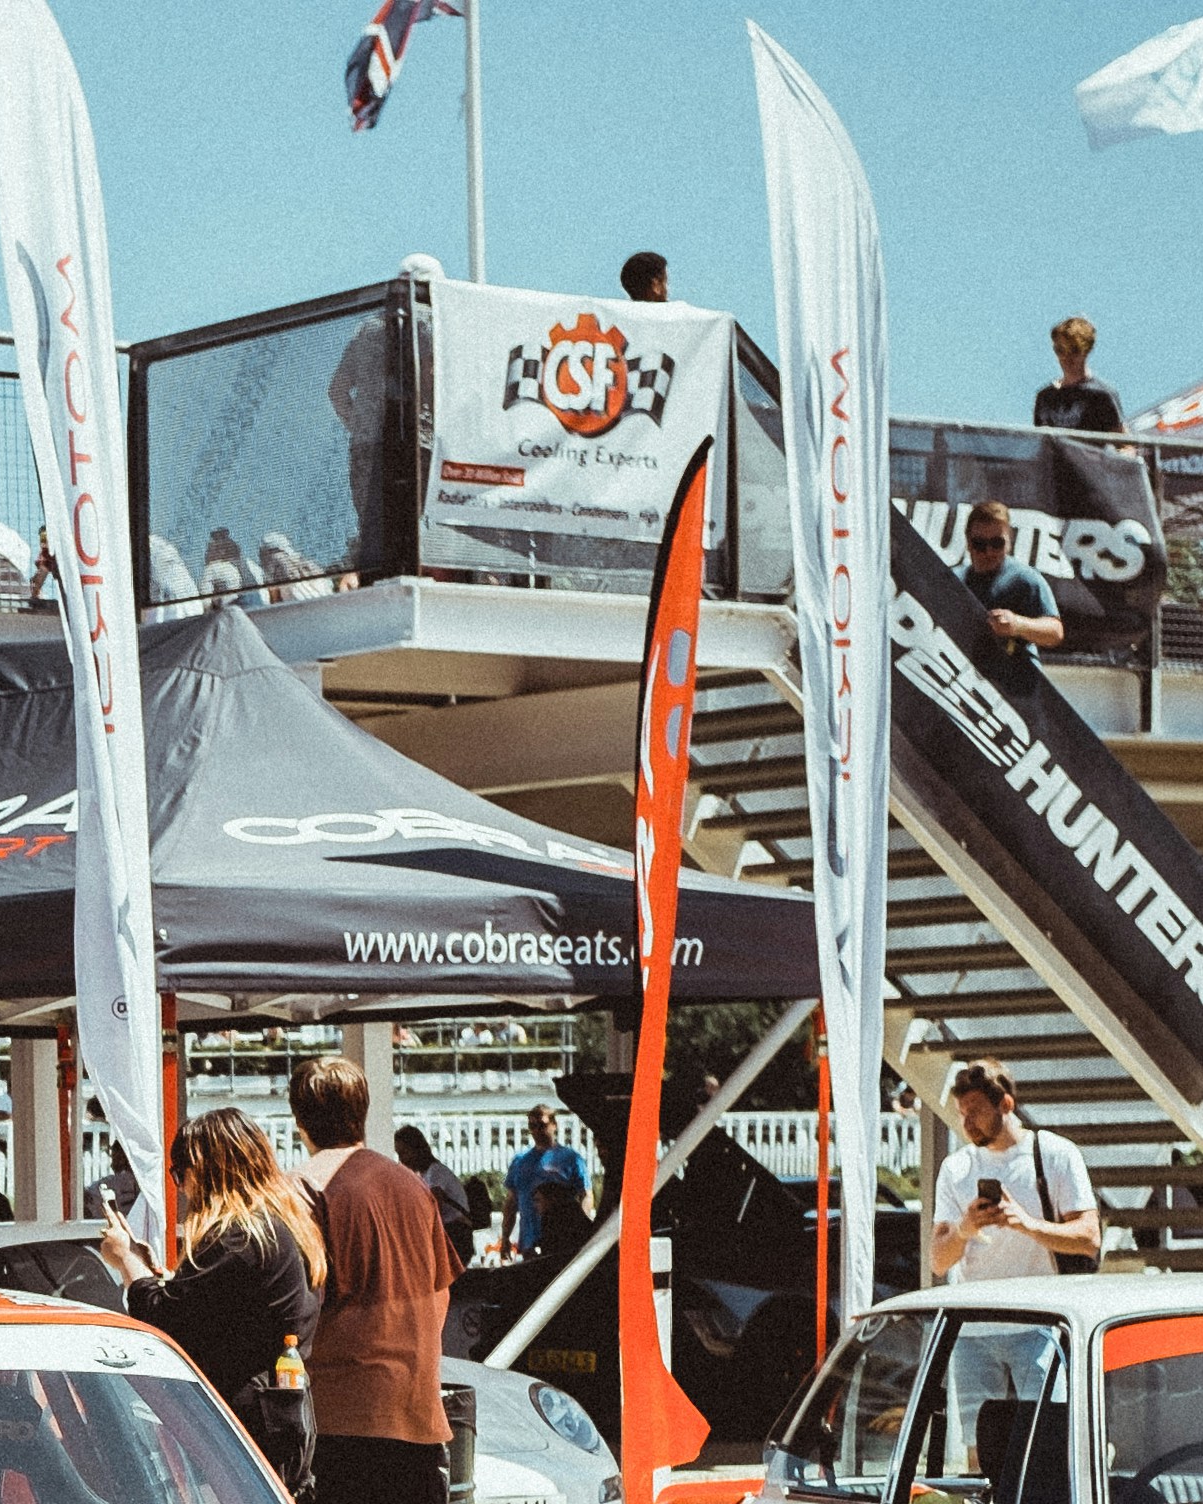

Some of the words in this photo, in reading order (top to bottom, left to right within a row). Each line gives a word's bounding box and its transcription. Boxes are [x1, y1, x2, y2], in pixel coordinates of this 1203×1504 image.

[543, 339, 618, 417] CSF
[518, 439, 589, 467] Cooling
[595, 446, 659, 472] Experts
[343, 920, 705, 967] www.cobraseats.m
